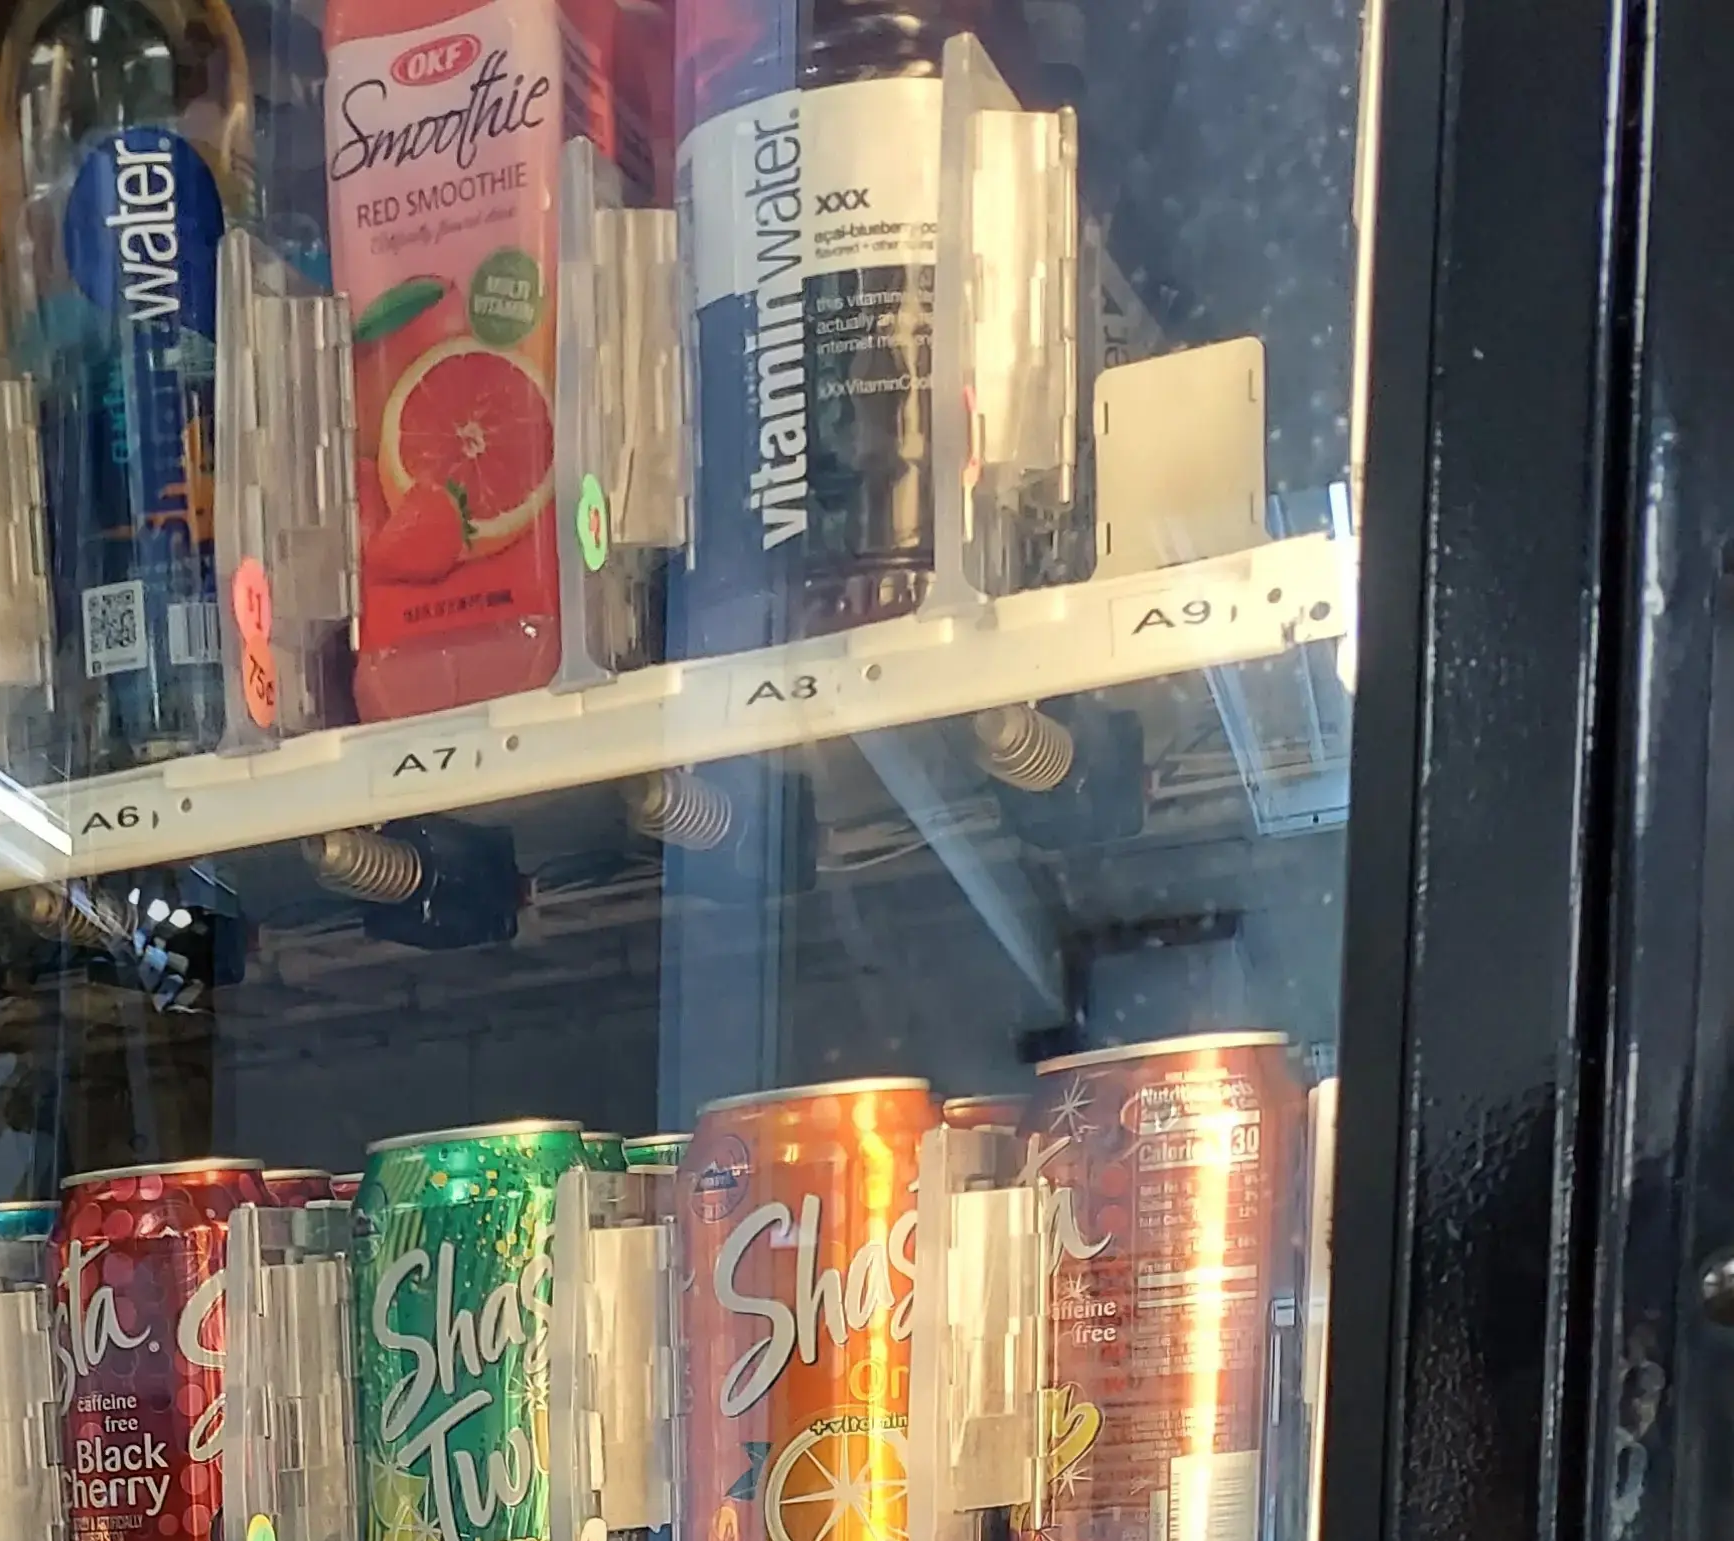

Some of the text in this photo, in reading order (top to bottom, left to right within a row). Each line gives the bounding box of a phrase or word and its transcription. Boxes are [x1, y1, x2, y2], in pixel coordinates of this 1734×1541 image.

[408, 44, 461, 78] OKF
[330, 50, 549, 181] Smoothie
[357, 163, 527, 229] RED SMOOTHIE
[1132, 599, 1210, 634] A9
[746, 676, 817, 704] A8
[392, 747, 457, 777] A7
[81, 806, 139, 835] A6
[1072, 1324, 1116, 1343] free
[77, 1395, 137, 1413] caffeine
[104, 1416, 139, 1433] free
[76, 1433, 169, 1474] Black
